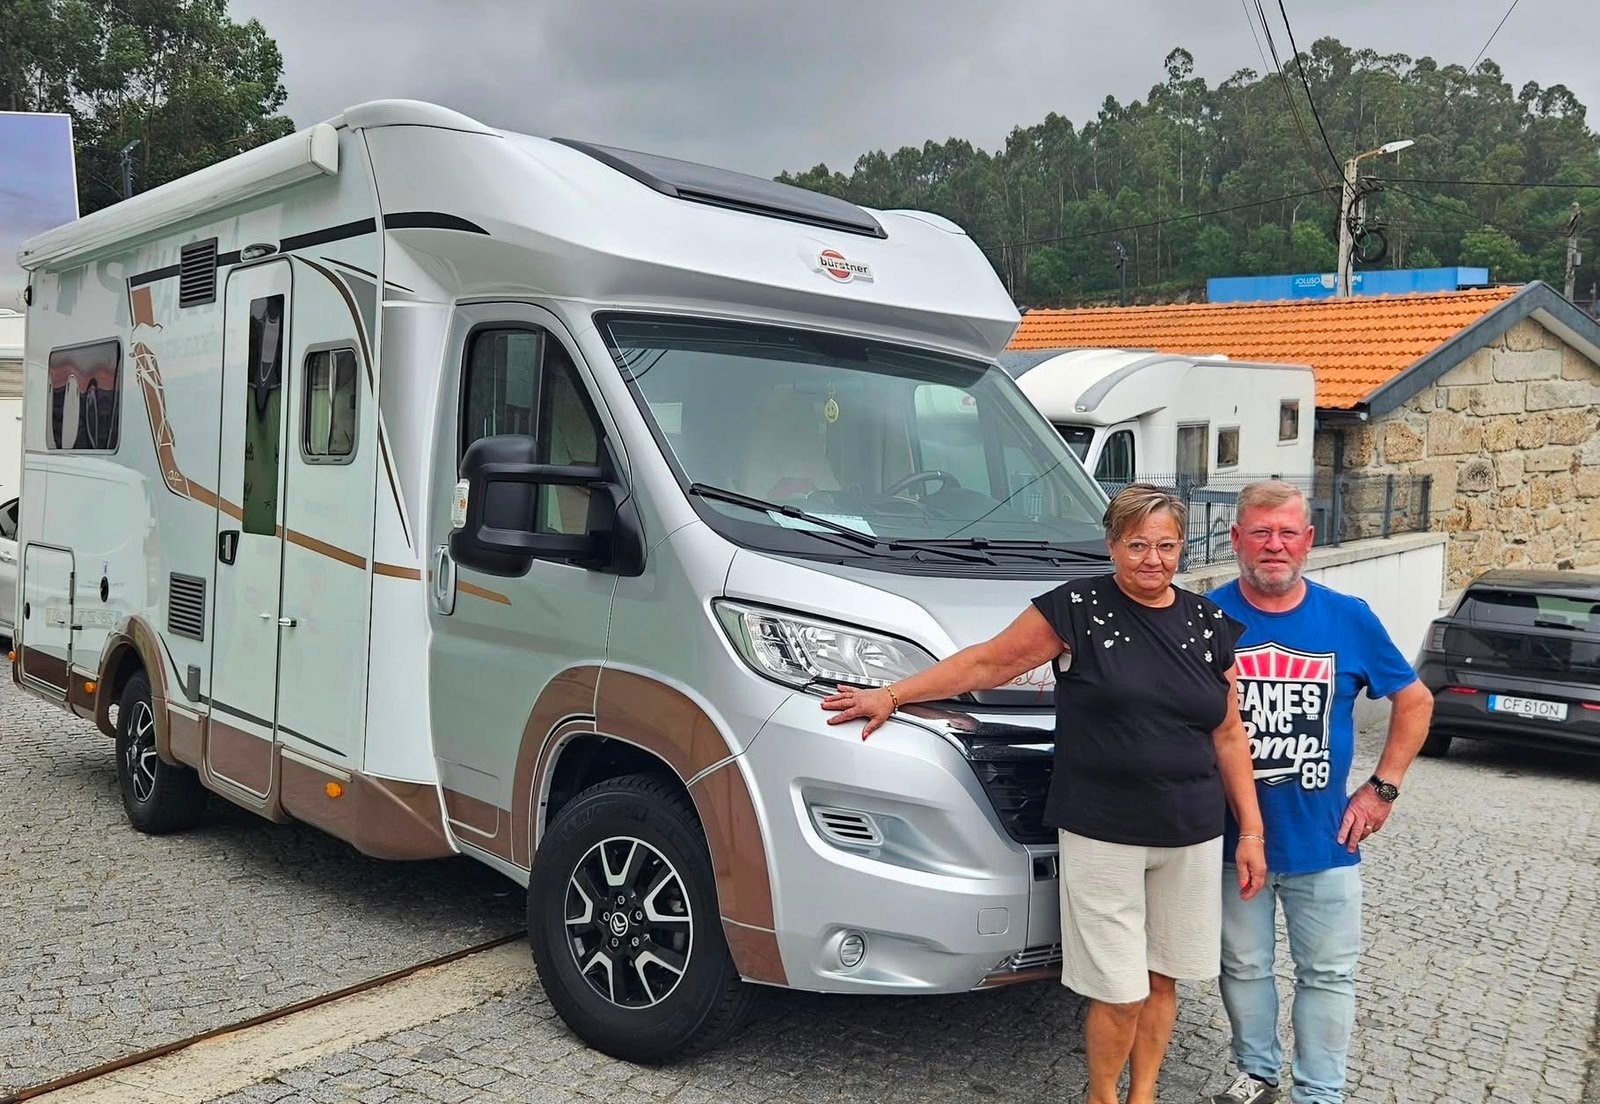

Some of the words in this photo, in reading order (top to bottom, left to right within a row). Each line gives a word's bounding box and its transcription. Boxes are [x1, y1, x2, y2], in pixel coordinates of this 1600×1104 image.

[819, 256, 868, 274] bürstner
[1251, 709, 1293, 734] NYC
[1301, 761, 1330, 790] 89
